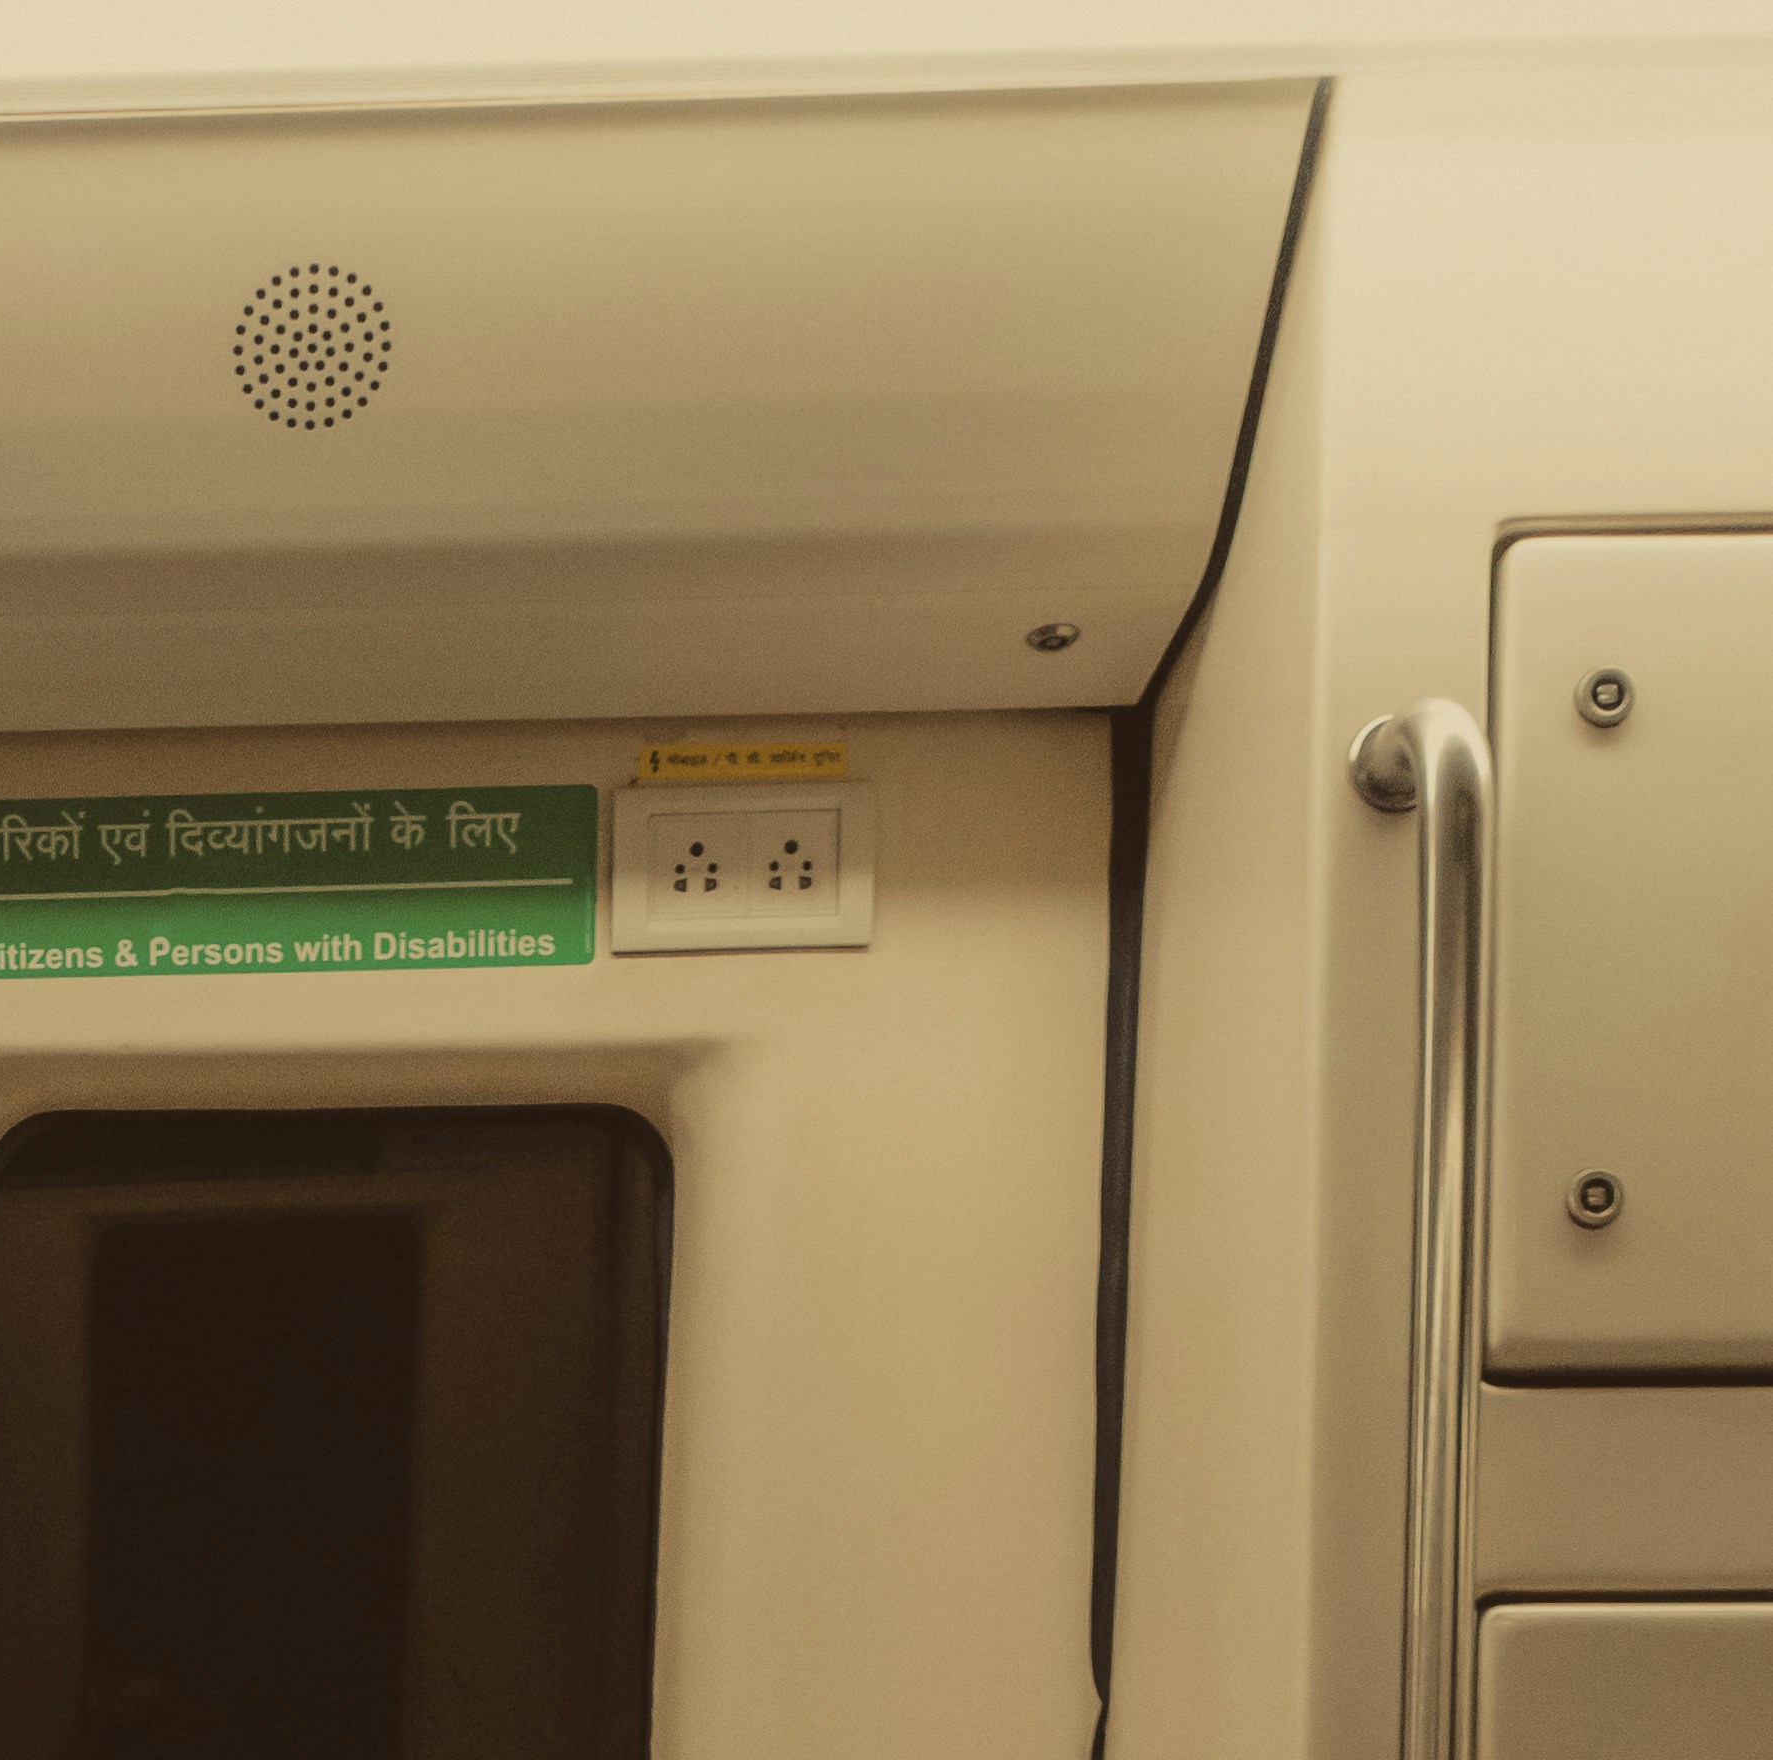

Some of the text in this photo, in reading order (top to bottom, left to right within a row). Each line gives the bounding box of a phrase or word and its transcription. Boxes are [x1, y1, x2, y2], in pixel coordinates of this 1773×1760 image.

[98, 809, 151, 865] एवं
[166, 802, 374, 857] दिव्यांगजनों
[389, 801, 426, 850] के
[446, 800, 521, 854] लिए
[114, 938, 138, 967] &
[149, 936, 285, 966] Persons
[294, 932, 363, 963] with
[373, 928, 556, 960] Disabilities
